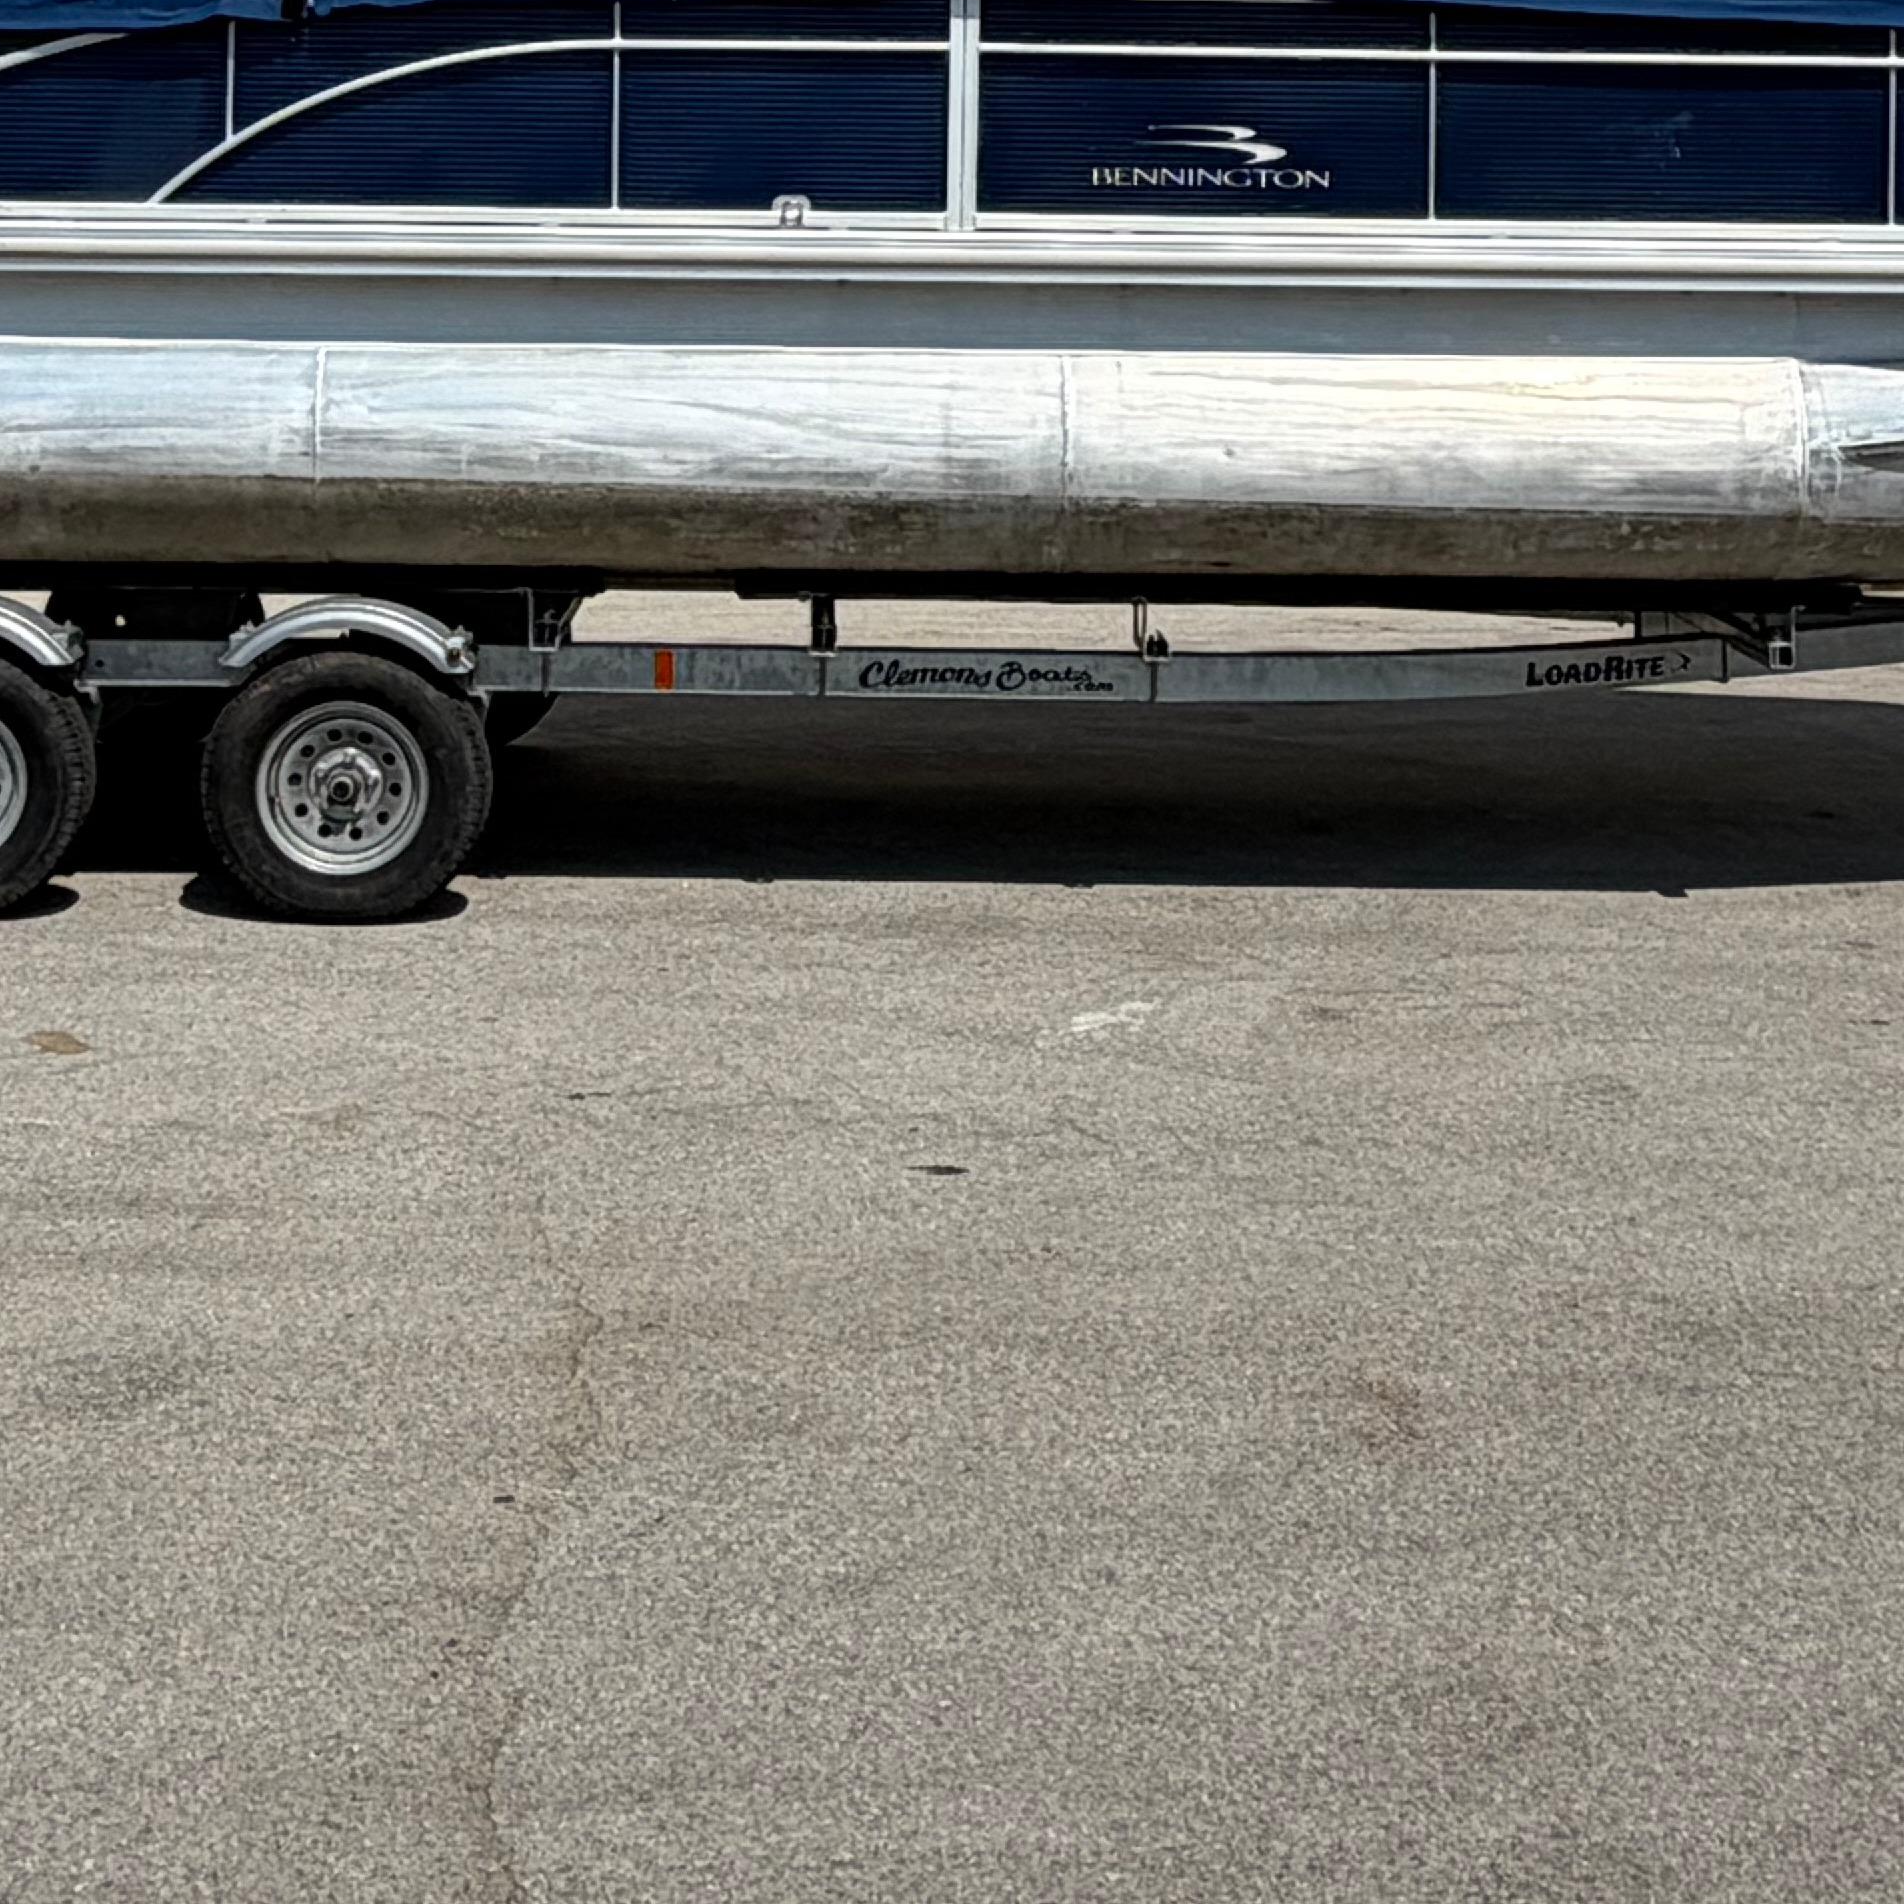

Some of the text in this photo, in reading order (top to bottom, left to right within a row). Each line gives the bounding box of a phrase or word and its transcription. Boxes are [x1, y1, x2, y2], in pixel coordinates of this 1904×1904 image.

[1091, 166, 1330, 190] BENNINGTON
[858, 659, 993, 689] Clemons
[996, 660, 1092, 692] Boats
